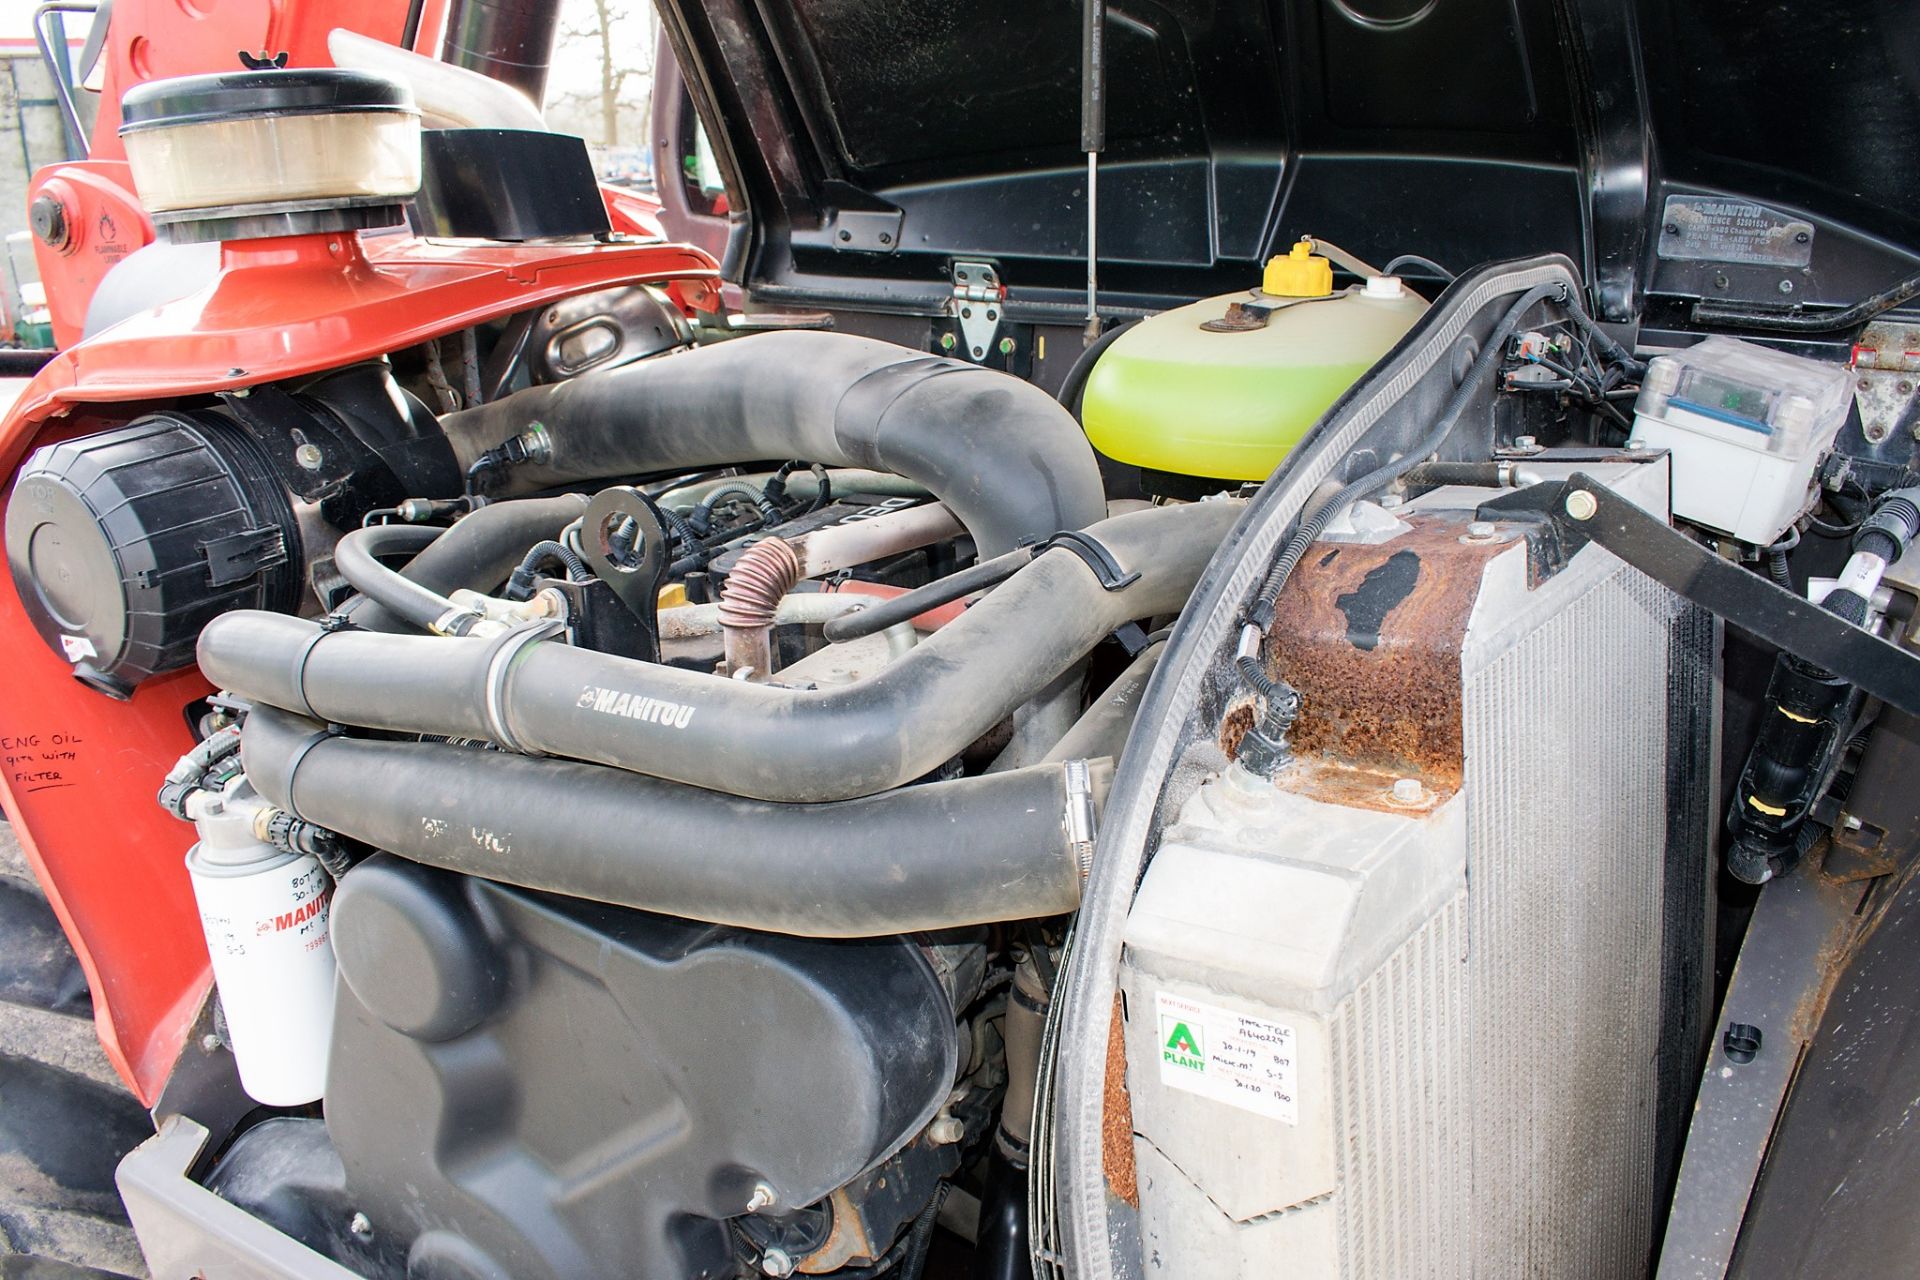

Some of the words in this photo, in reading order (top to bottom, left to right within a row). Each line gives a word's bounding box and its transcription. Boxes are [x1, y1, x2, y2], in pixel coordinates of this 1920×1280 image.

[1702, 203, 1763, 217] MANITOU
[592, 687, 697, 729] MANITOU
[1, 735, 41, 750] ENG
[1166, 1022, 1202, 1057] A
[1163, 1051, 1206, 1072] PLANT
